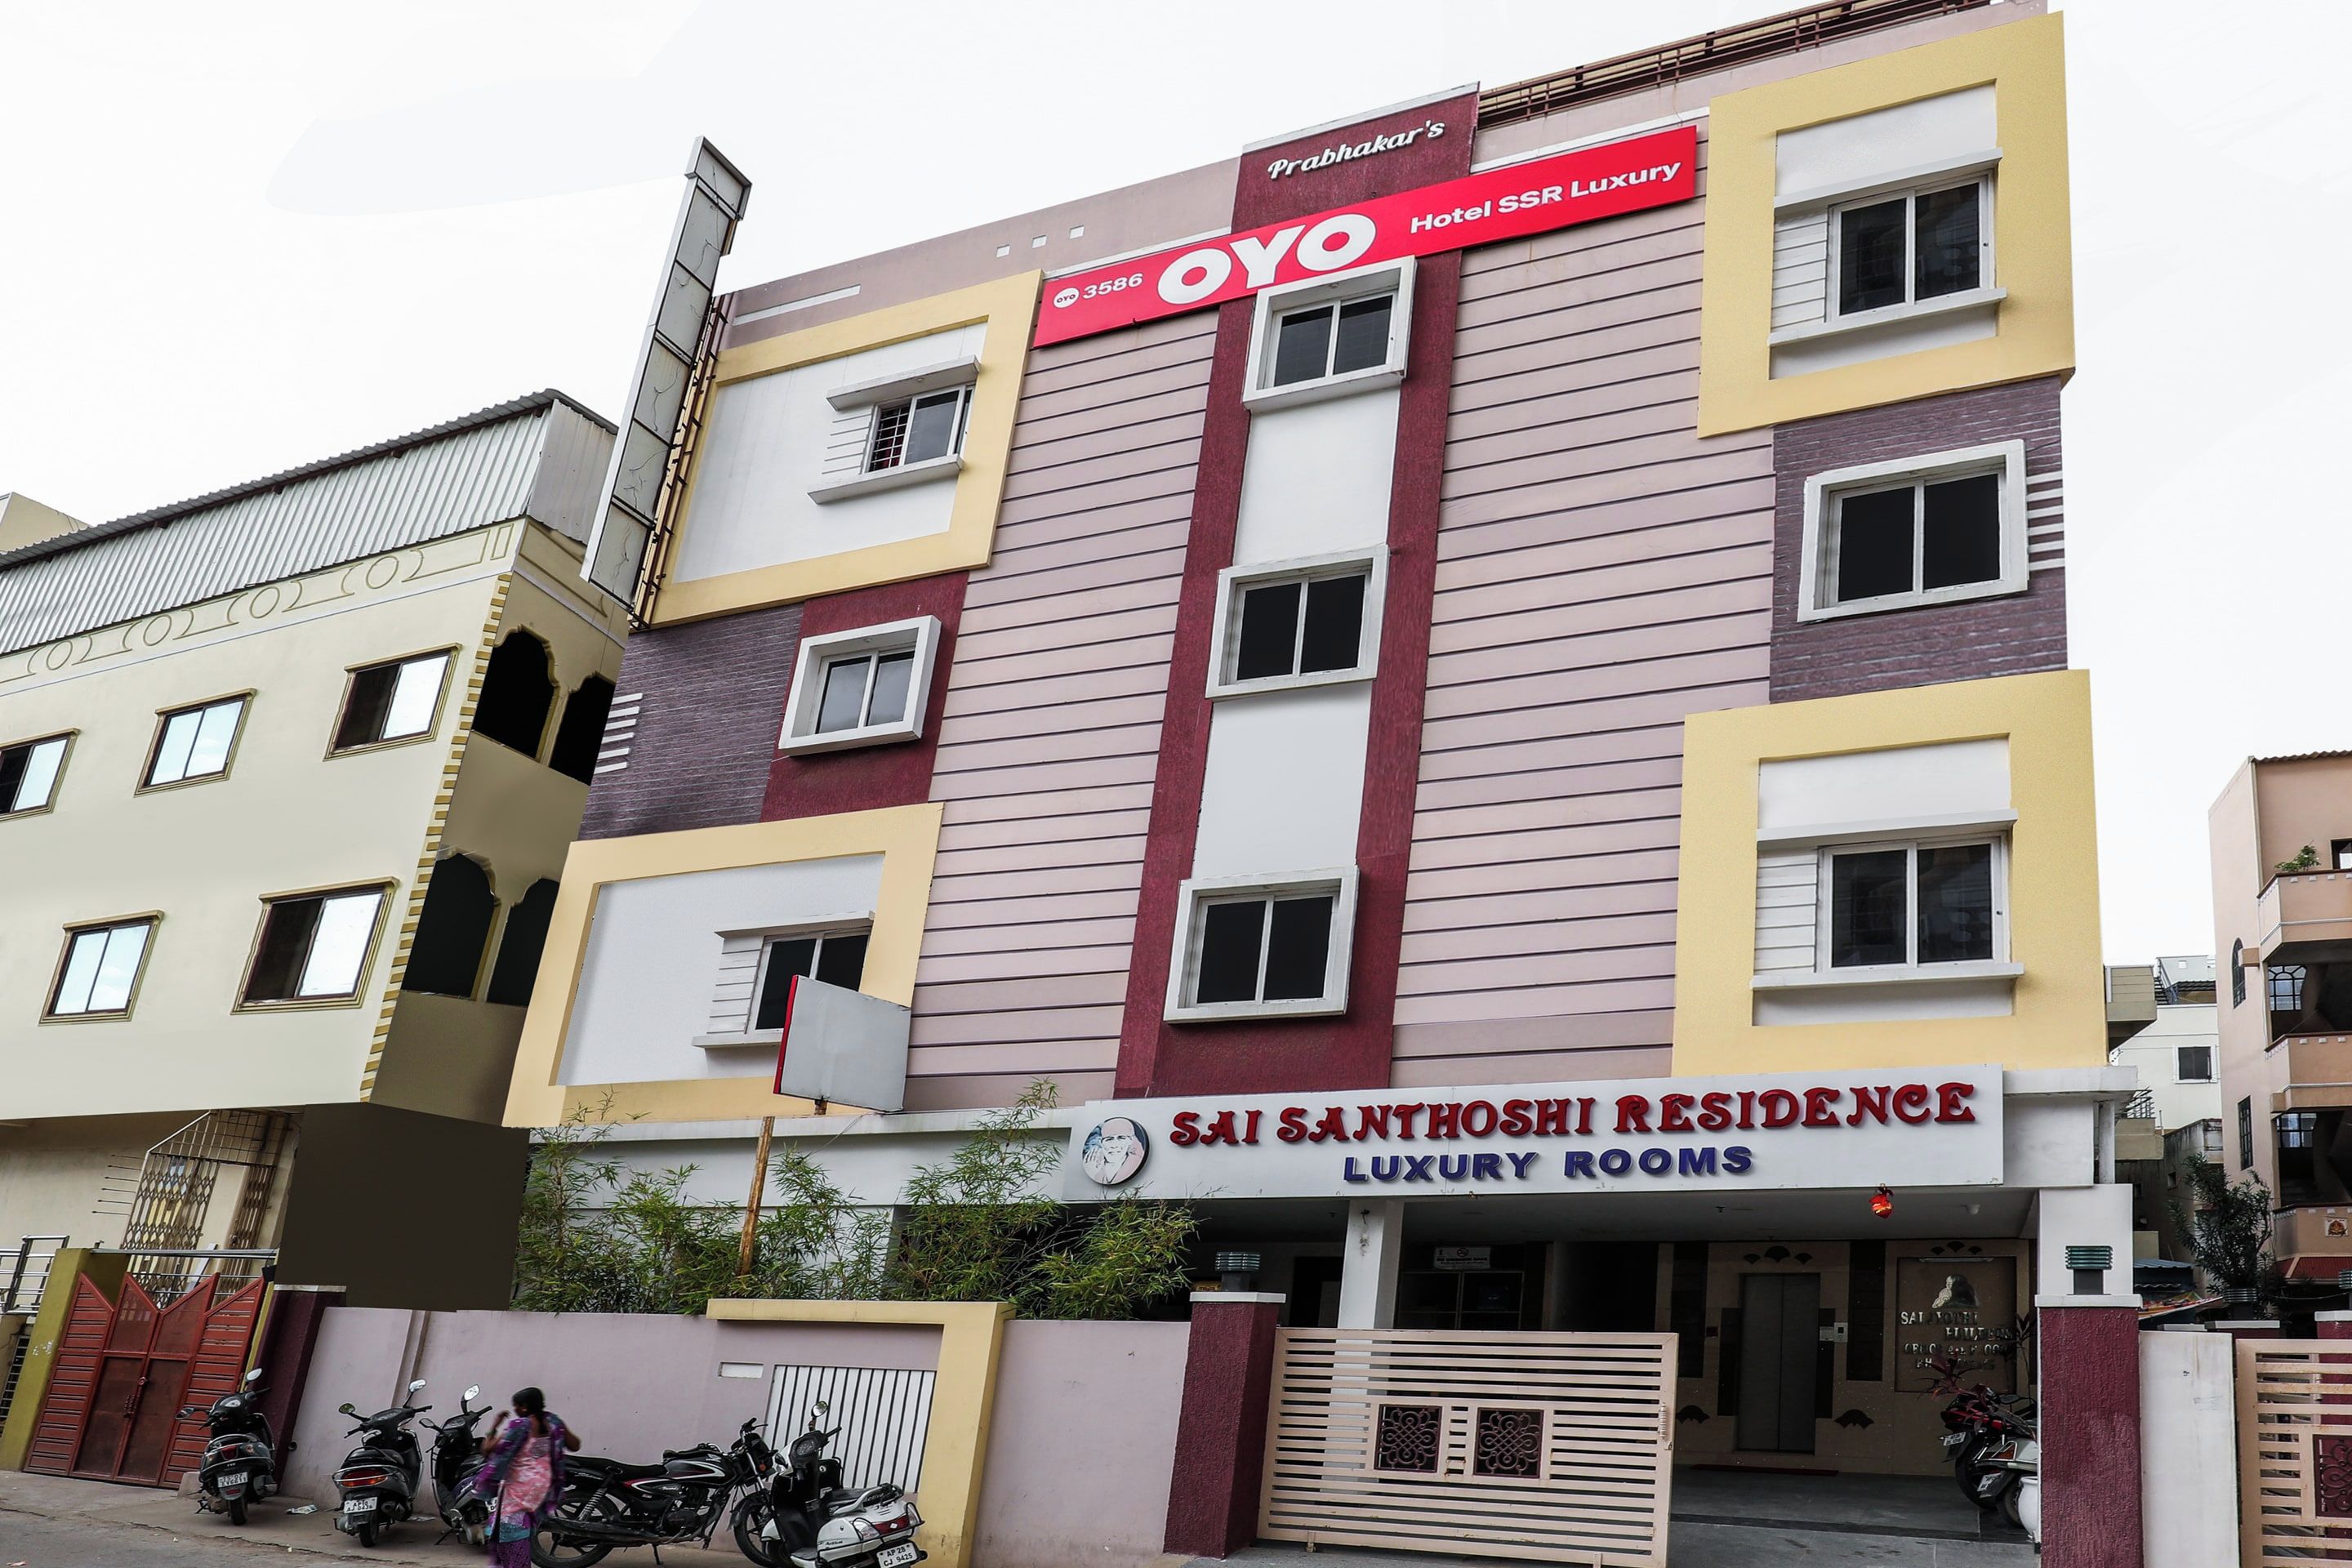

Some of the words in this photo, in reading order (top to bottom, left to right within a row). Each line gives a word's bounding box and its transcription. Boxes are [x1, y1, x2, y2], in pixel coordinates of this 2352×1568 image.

[1267, 120, 1445, 180] Prabhakar's
[1410, 199, 1492, 234] Hotel
[1497, 185, 1564, 214] SSR
[1570, 162, 1682, 198] Luxury
[1157, 213, 1376, 305] OYO
[1082, 272, 1143, 300] 3586
[1169, 1108, 1263, 1146] SAI
[1276, 1096, 1597, 1143] SANTHOSHI
[1612, 1081, 1976, 1134] RESIDENCE
[1342, 1151, 1539, 1183] LUXURY
[1563, 1145, 1754, 1178] ROOMS
[1900, 1311, 1924, 1325] SAI
[896, 1552, 913, 1562] 9425
